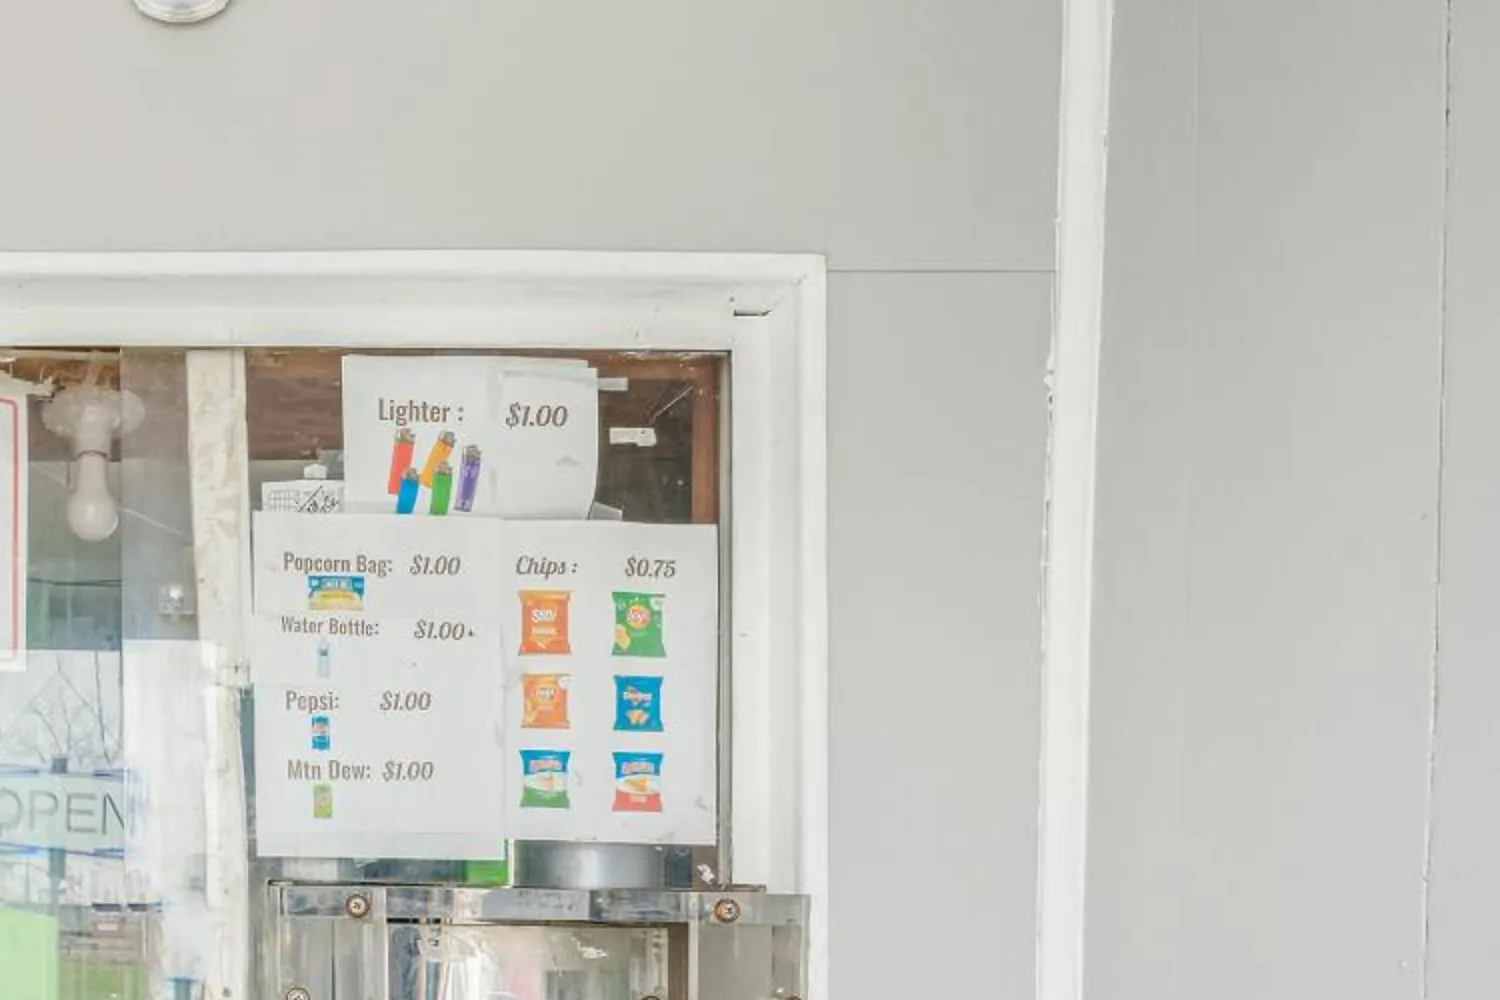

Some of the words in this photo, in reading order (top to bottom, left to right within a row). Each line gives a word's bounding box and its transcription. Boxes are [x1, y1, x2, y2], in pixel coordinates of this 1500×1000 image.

[379, 399, 451, 426] Lighter
[505, 403, 567, 428] $1.00
[283, 552, 351, 574] Popcorn
[356, 555, 392, 577] Bag:
[409, 555, 461, 575] $1.00
[515, 556, 566, 579] Chips
[625, 558, 676, 578] $0.75
[281, 616, 324, 634] Water
[329, 617, 379, 636] Bottle:
[285, 690, 339, 713] Pepsi:
[380, 691, 431, 710] $1.00
[287, 759, 321, 779] Mtn
[329, 760, 371, 780] Dew:
[382, 762, 434, 781] $1.00
